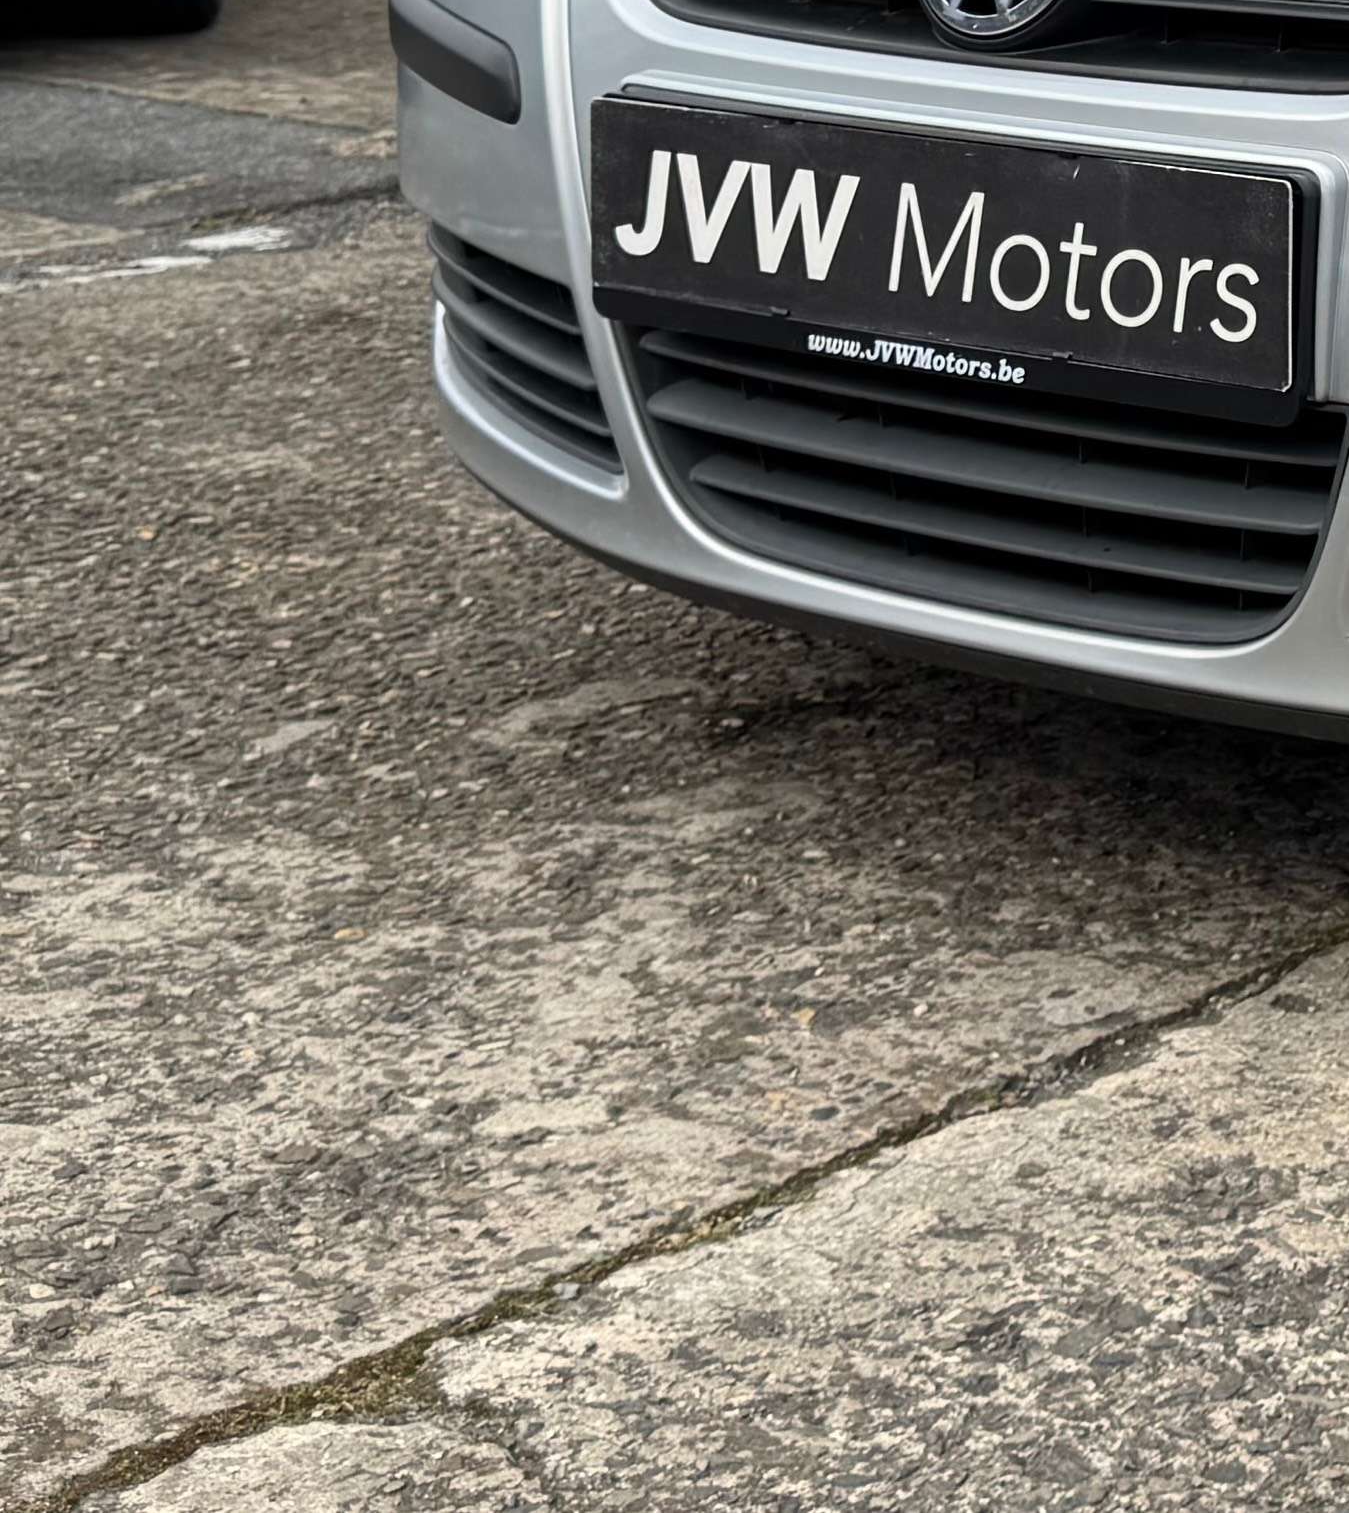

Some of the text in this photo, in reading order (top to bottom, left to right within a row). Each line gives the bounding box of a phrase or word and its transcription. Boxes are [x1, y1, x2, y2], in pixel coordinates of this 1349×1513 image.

[615, 149, 1259, 344] JVW Motors
[807, 333, 1027, 385] www.JVWMotors.be
